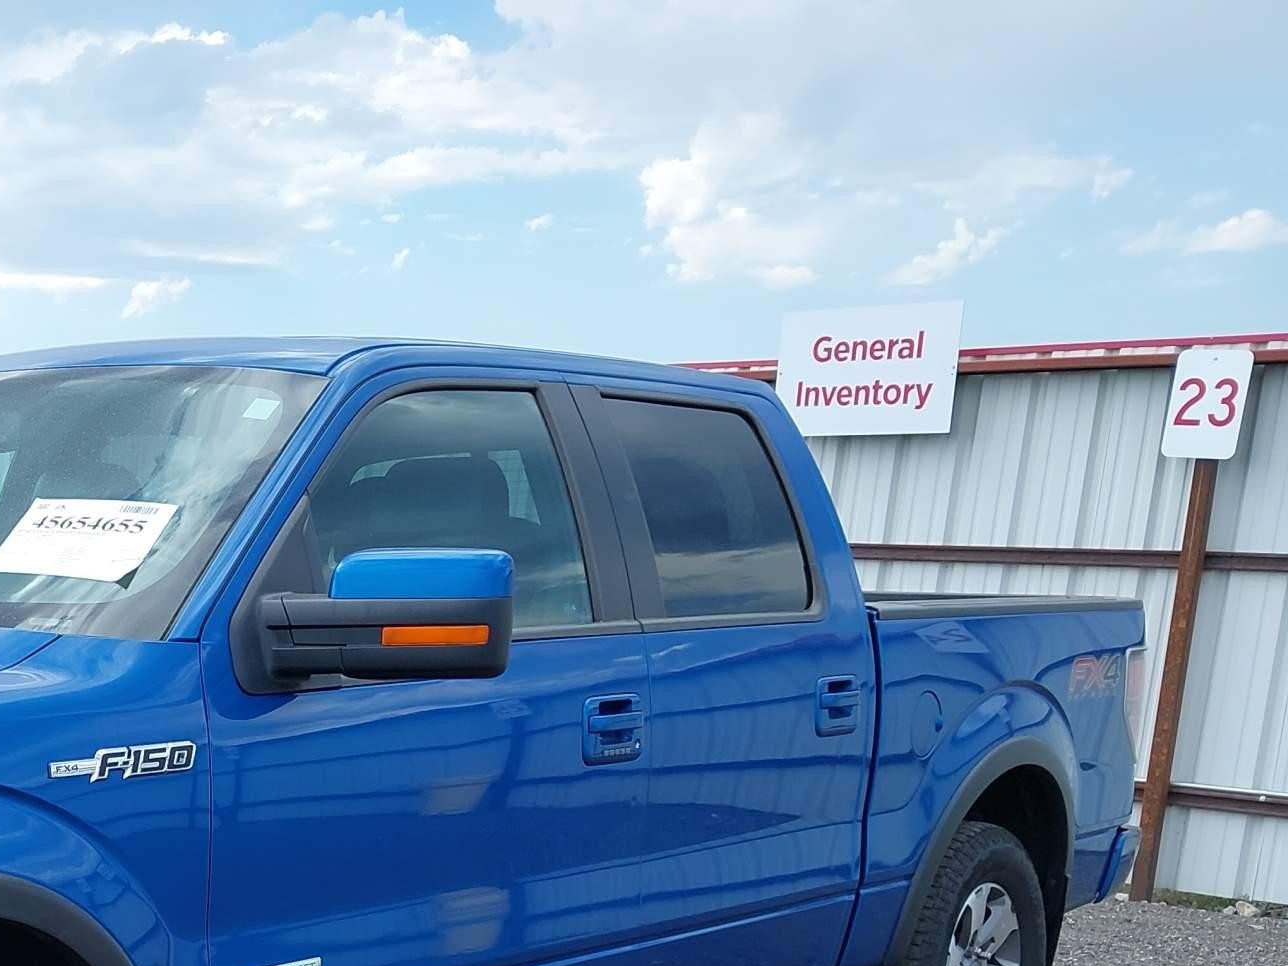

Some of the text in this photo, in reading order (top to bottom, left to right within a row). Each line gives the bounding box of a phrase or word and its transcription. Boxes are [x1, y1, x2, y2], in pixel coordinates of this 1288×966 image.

[812, 330, 925, 363] General
[795, 379, 934, 410] Inventory
[1172, 377, 1240, 428] 23
[31, 514, 148, 535] 45654655
[1068, 653, 1121, 693] FX4
[54, 742, 196, 780] FX4 F-150
